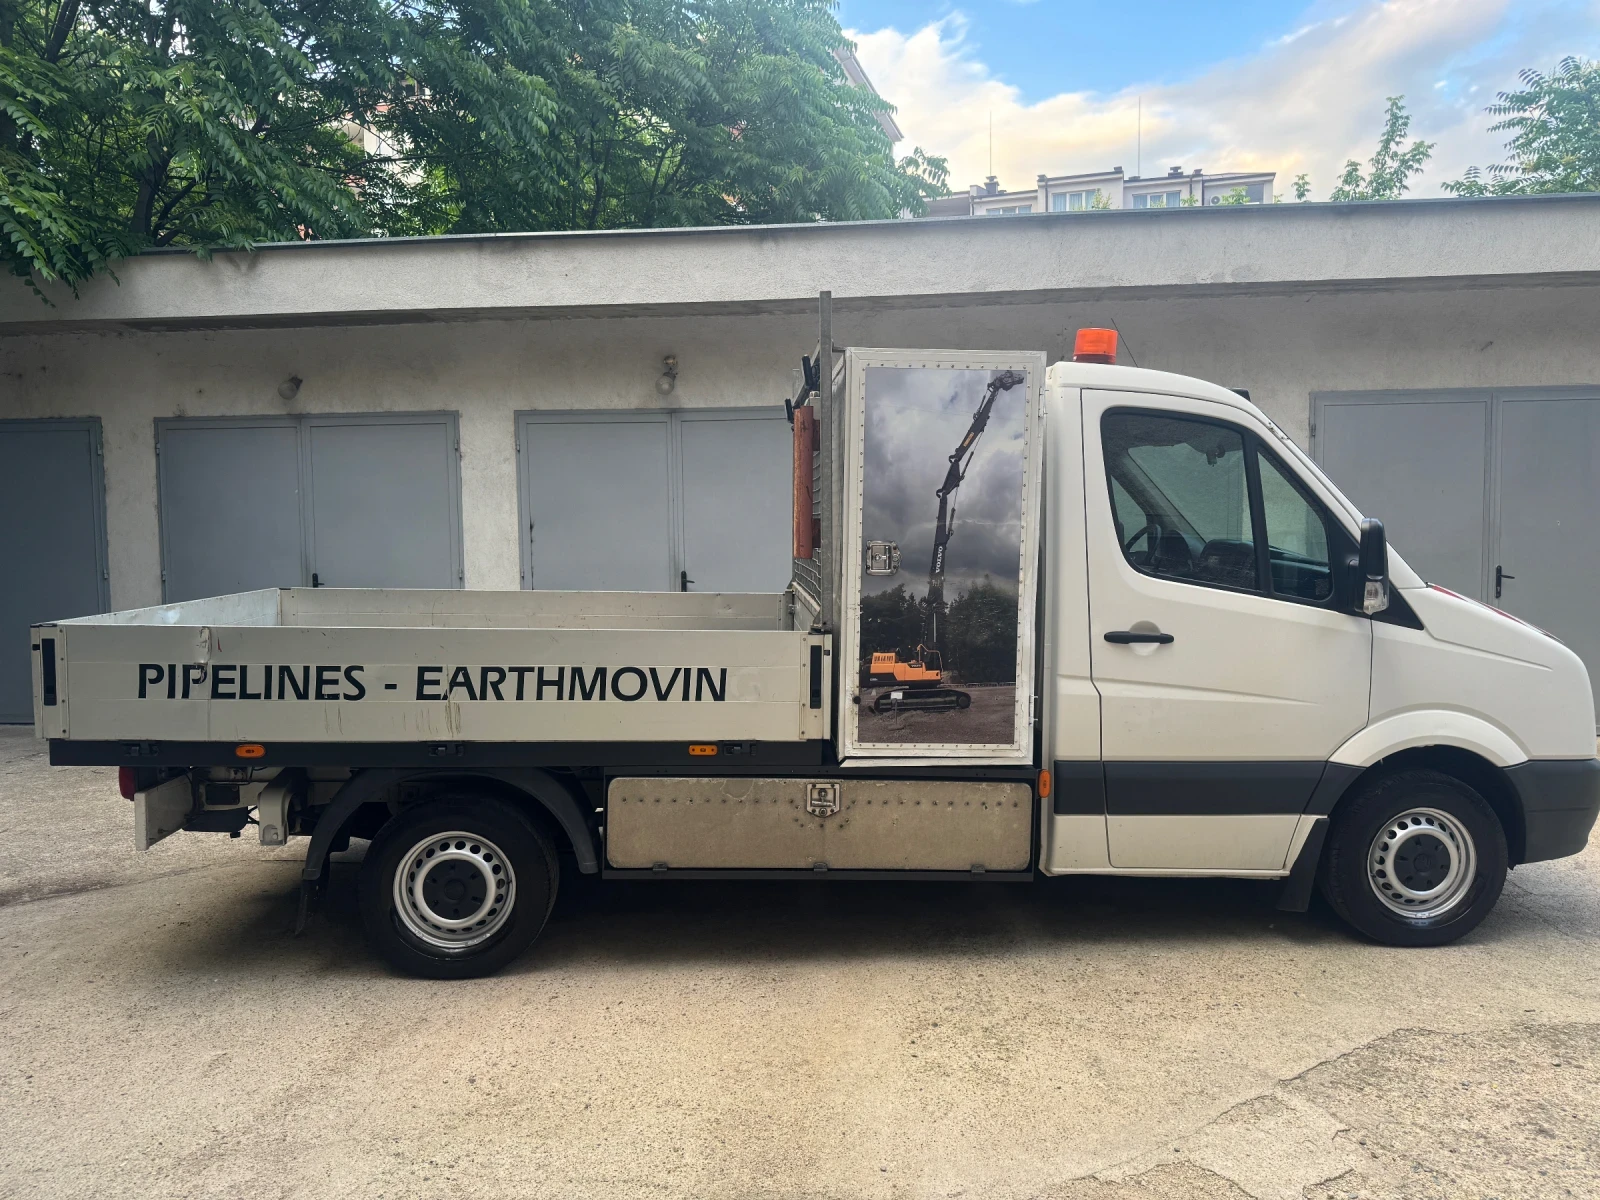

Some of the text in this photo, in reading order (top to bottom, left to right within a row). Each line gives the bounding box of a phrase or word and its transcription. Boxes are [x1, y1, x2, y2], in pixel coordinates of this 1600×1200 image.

[935, 545, 943, 573] VOLVO
[137, 664, 366, 701] PIPELINES
[415, 666, 727, 702] EARTHMOVIN
